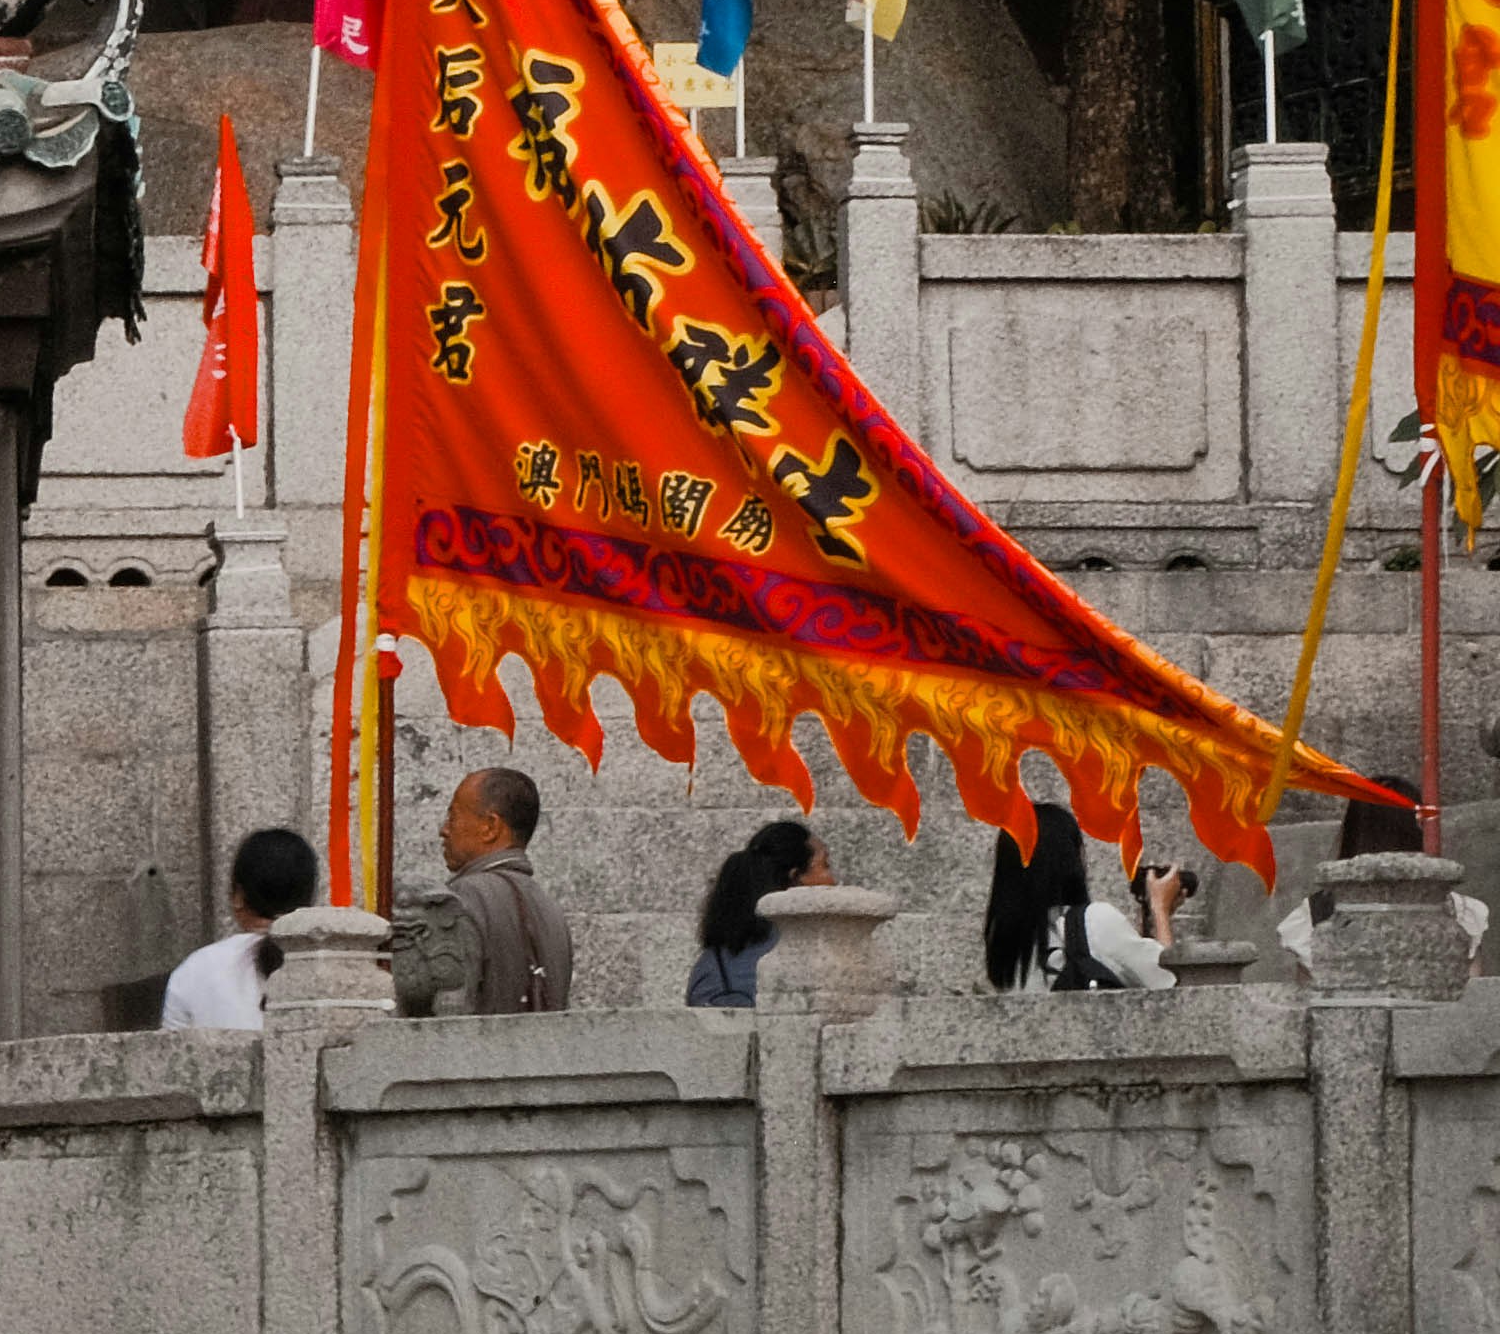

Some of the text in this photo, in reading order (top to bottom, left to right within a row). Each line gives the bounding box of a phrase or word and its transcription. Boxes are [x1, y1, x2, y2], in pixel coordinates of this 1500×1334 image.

[515, 440, 775, 556] 澳門媽閣廟
